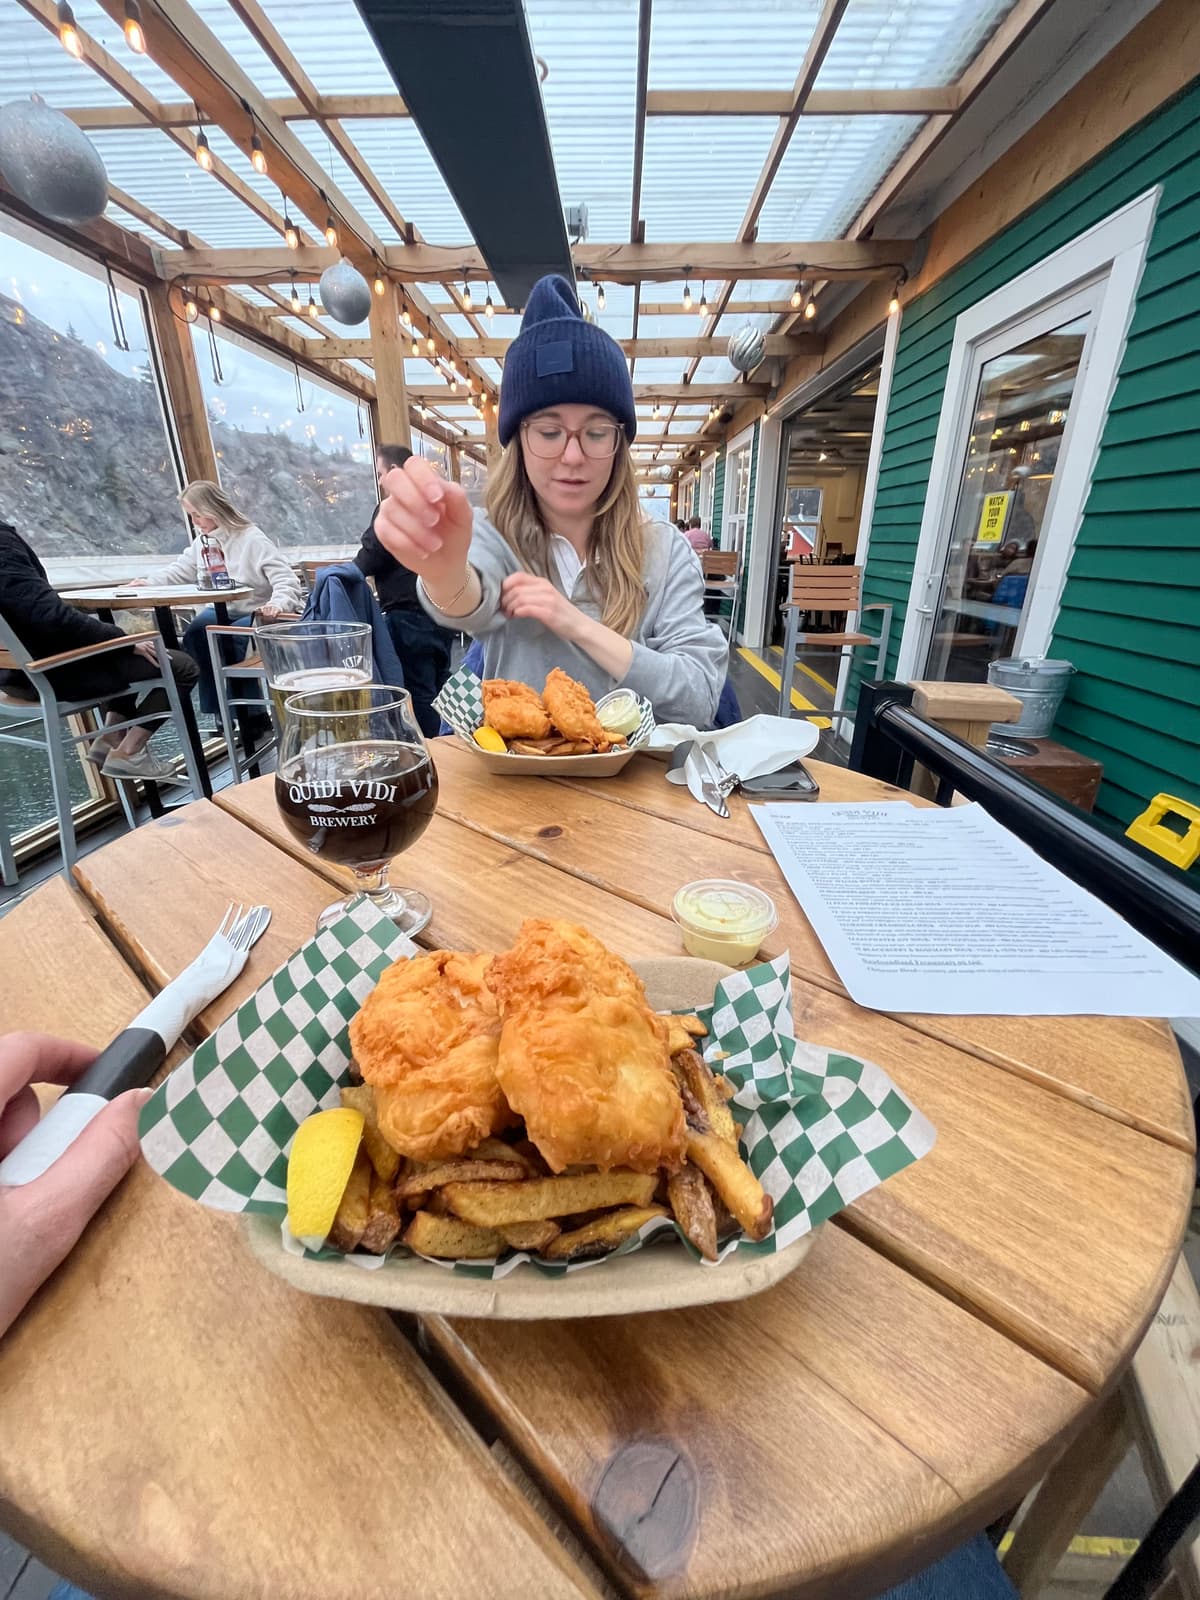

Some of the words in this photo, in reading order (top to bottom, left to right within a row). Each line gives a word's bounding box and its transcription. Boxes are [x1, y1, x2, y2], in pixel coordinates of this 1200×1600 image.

[989, 495, 1005, 506] WATCH
[988, 507, 1001, 517] YOUR
[986, 518, 998, 528] STEP
[289, 779, 343, 803] QUIDI
[350, 779, 398, 803] VIDI
[309, 814, 378, 828] BREWERY
